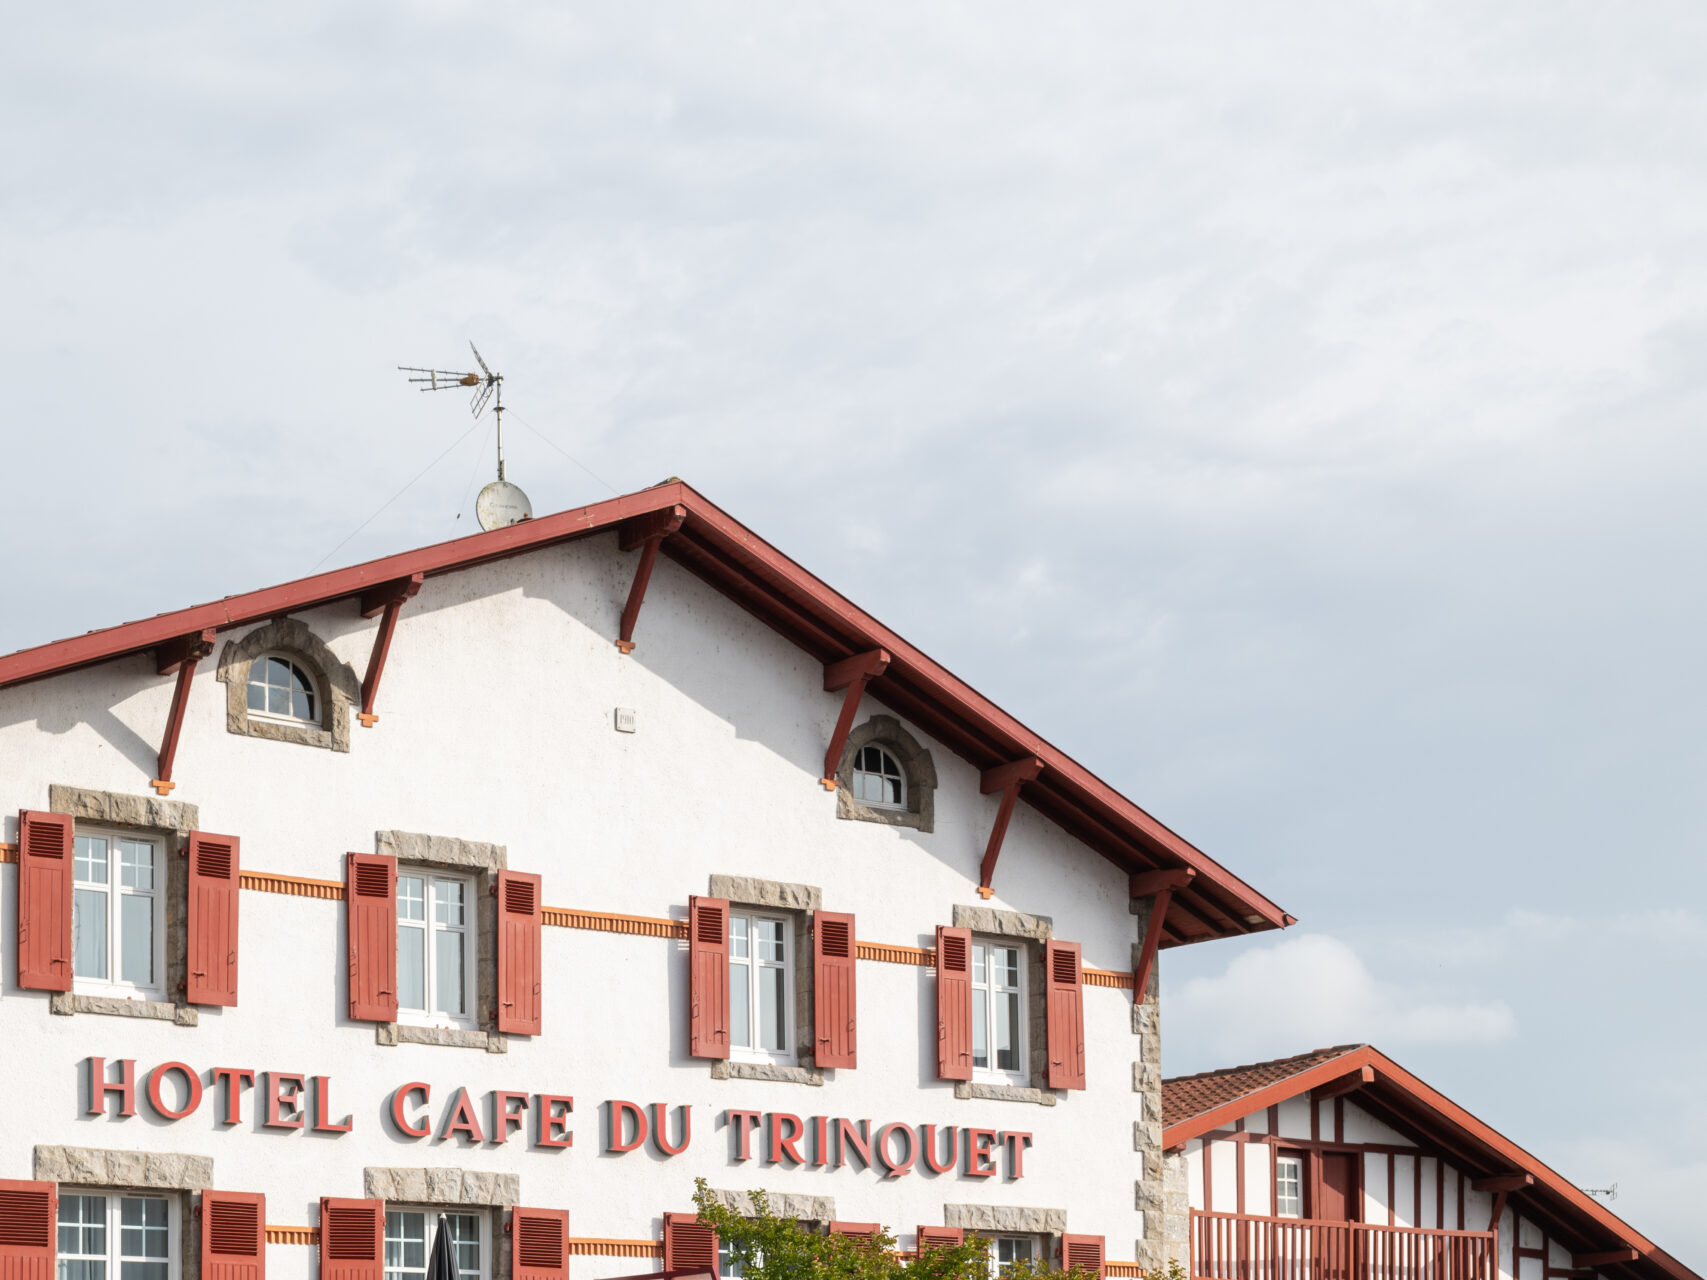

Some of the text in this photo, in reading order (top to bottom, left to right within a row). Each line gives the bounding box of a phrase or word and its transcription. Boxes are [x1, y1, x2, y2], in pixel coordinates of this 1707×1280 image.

[87, 1056, 1033, 1180] HOTEL CAFE DU TRINQUET
